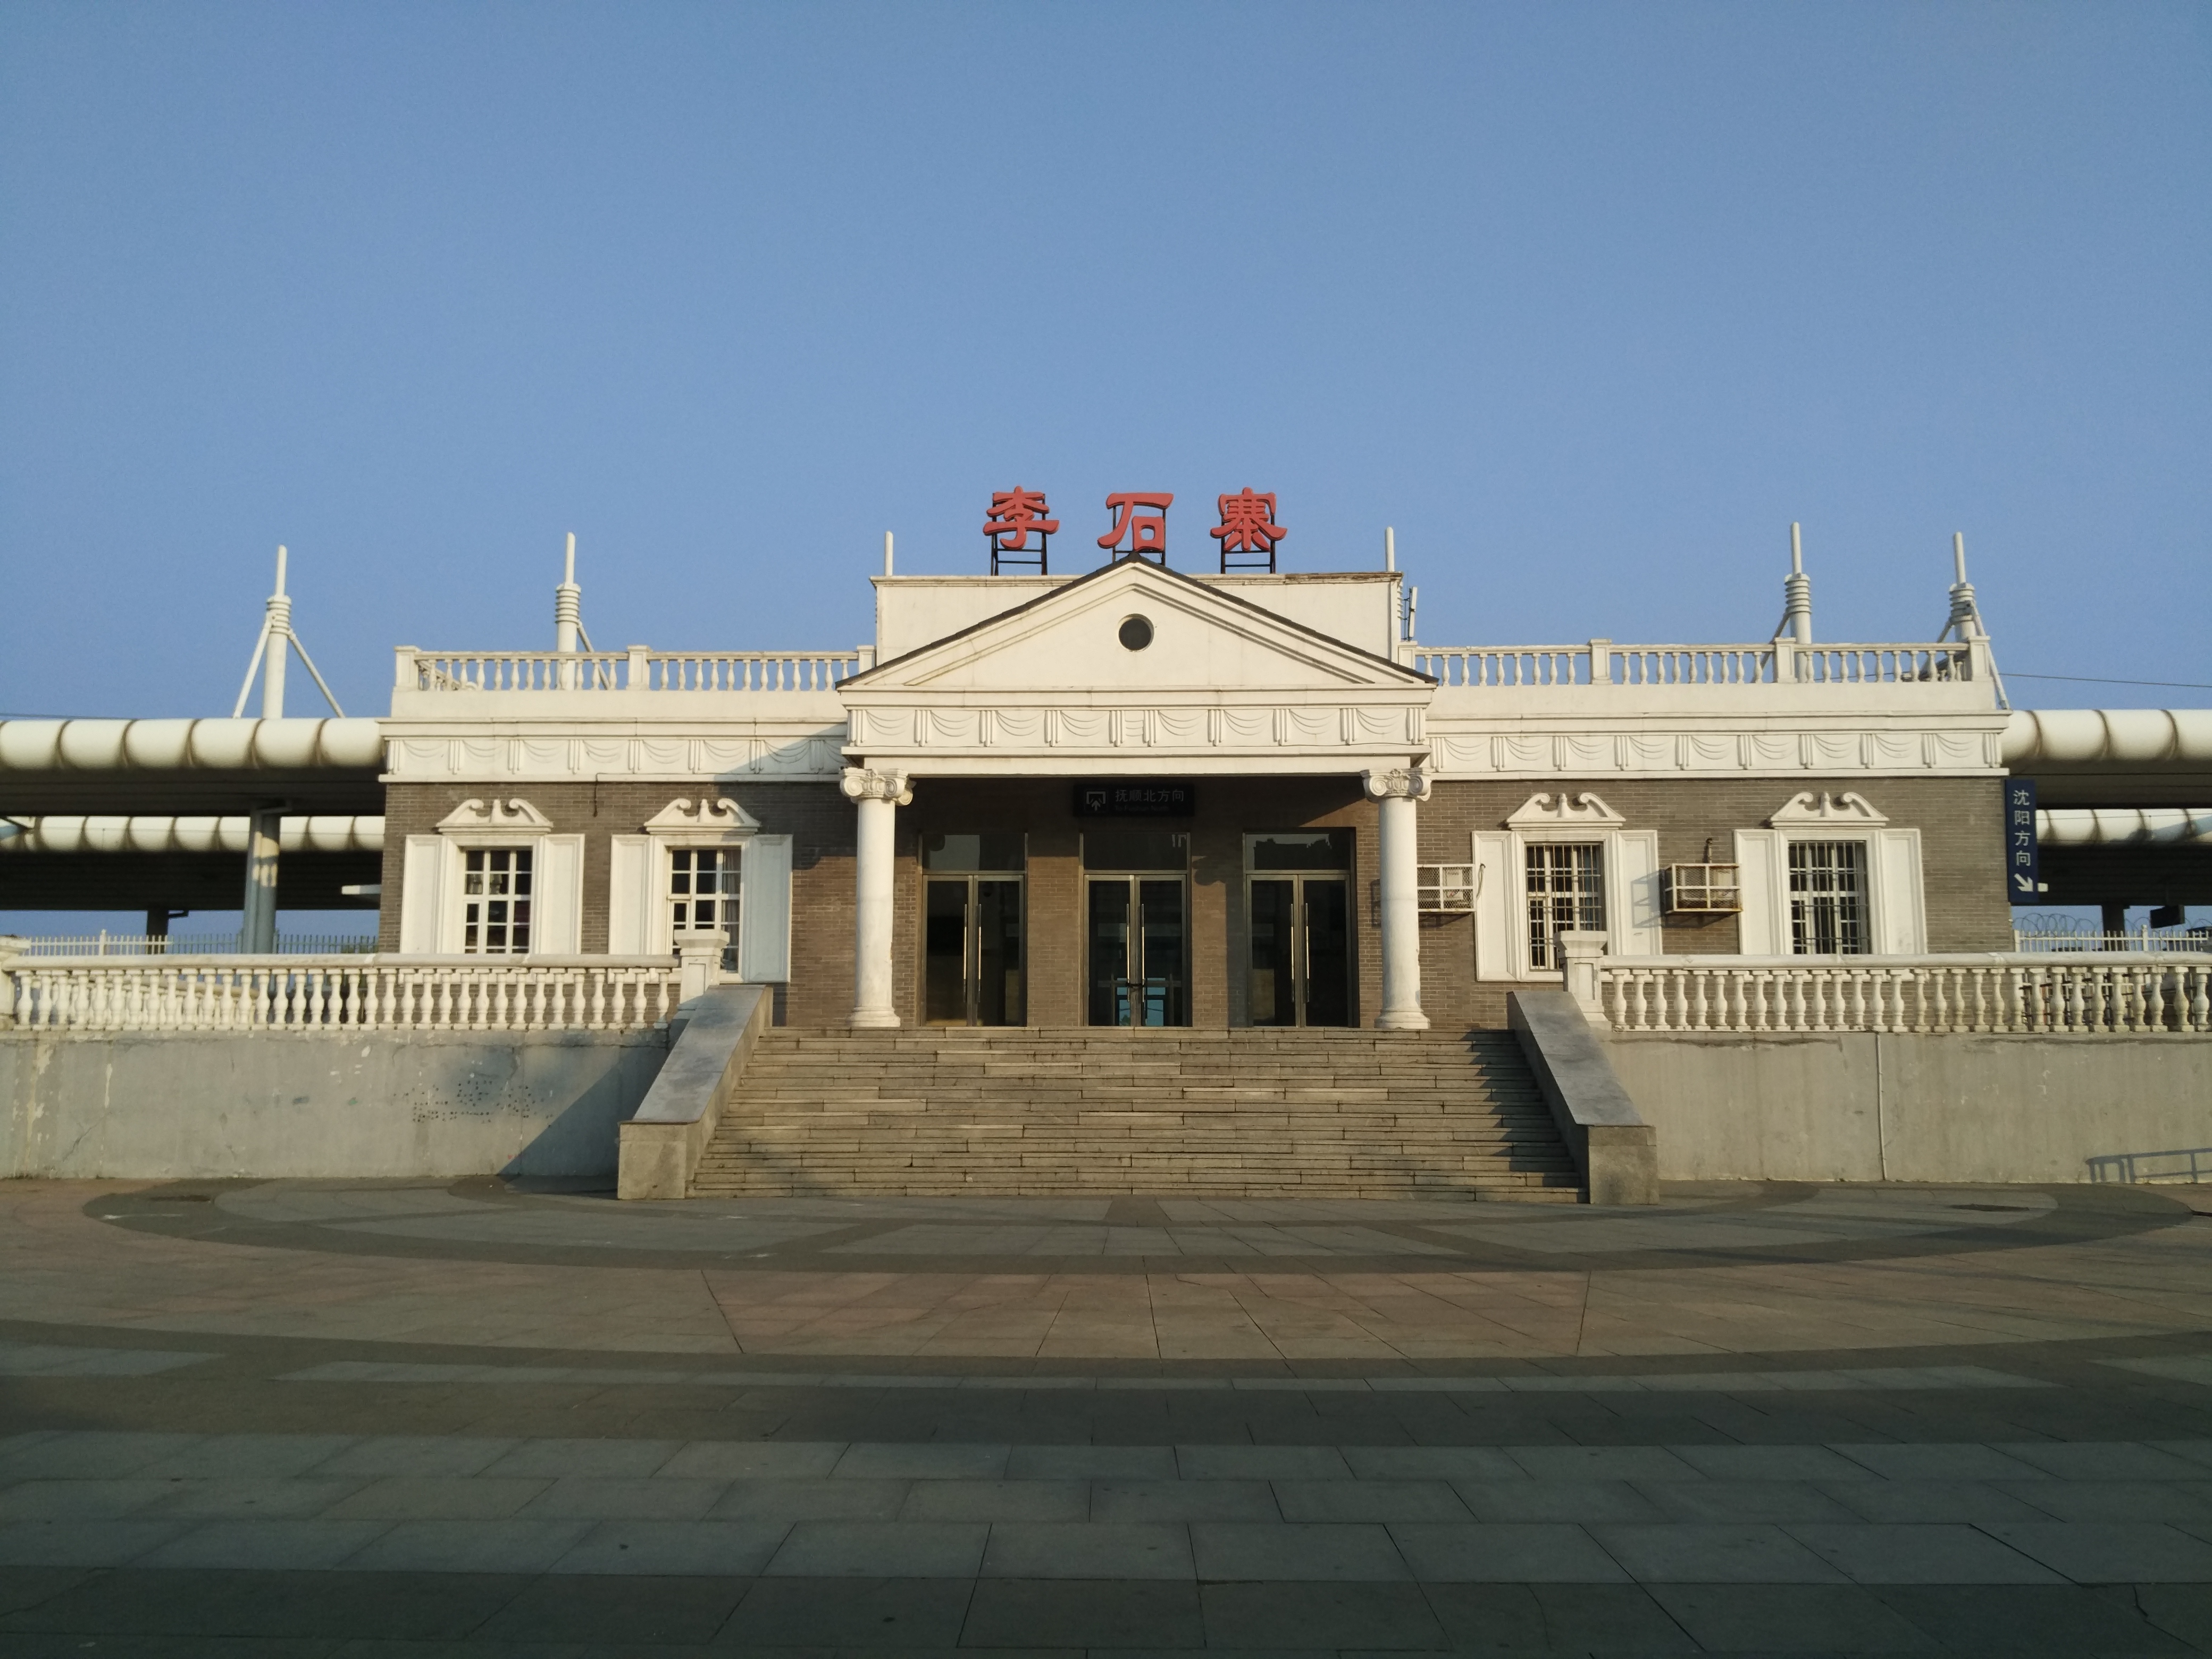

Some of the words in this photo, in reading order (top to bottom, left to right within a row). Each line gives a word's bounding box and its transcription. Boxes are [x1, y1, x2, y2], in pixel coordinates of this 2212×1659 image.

[983, 486, 1287, 551] 李石寨
[1115, 789, 1184, 802] 抚顺北方向
[2013, 790, 2031, 866] 沈阳方向
